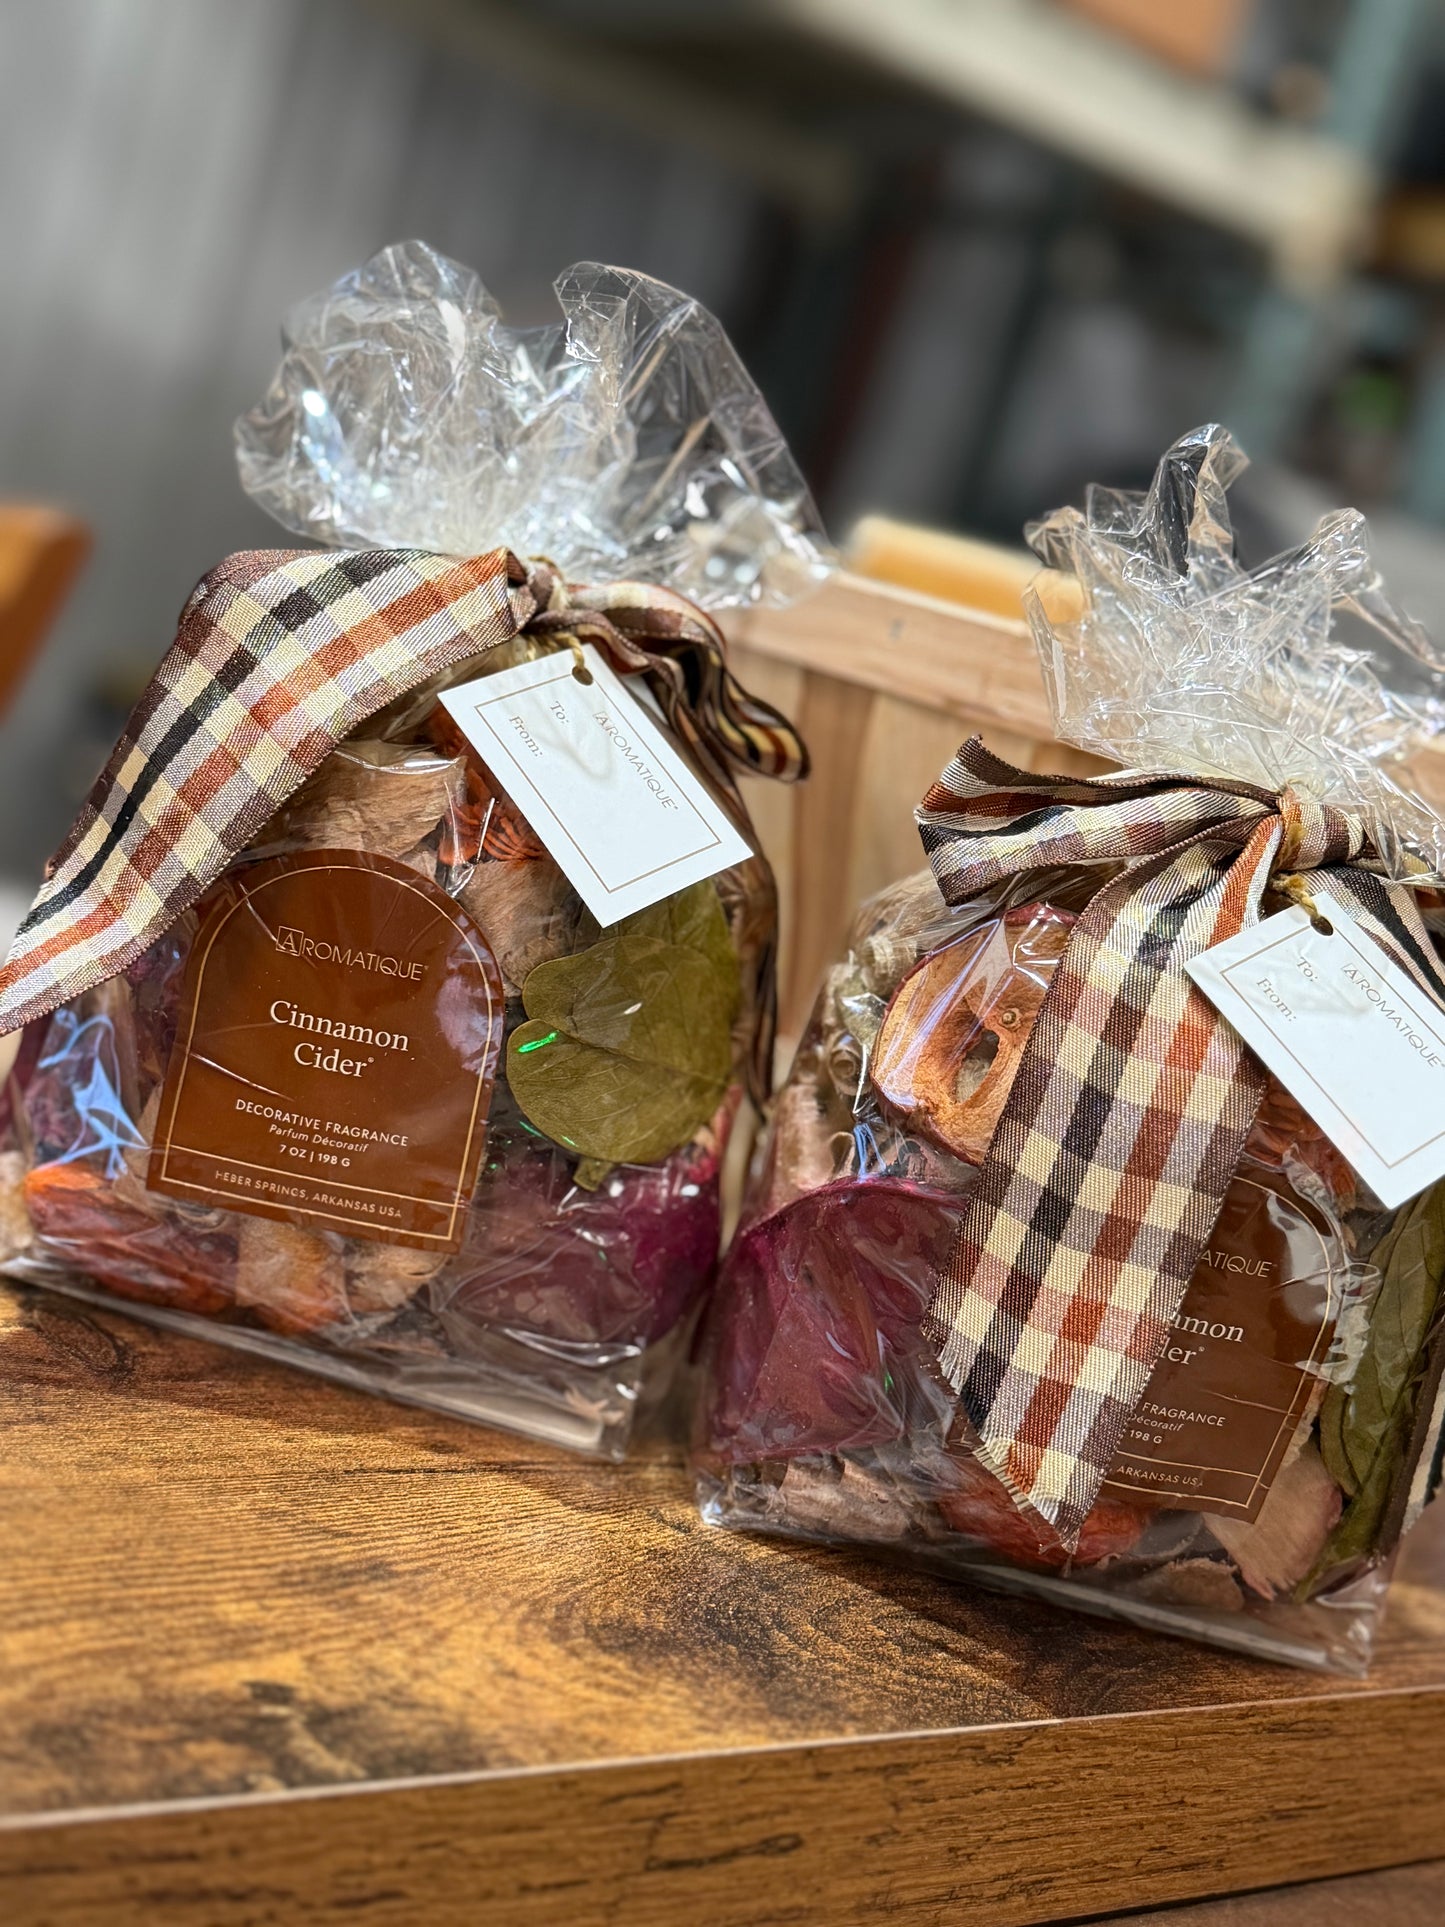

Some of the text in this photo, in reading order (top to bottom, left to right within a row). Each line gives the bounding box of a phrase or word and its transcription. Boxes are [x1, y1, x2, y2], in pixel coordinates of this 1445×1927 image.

[550, 701, 570, 727] To:
[509, 715, 543, 757] From:
[592, 710, 676, 809] AROMATIQUE
[275, 925, 424, 982] AROMATIQUE
[1295, 957, 1320, 983] To:
[1256, 977, 1297, 1022] From:
[1340, 962, 1442, 1068] AROMATIQUE
[270, 1000, 409, 1052] Cinnamon
[235, 1099, 409, 1147] DECORATIVE FRAGRANCE
[269, 1124, 369, 1153] Parfum Décoratif
[279, 1145, 287, 1153] 7
[289, 1147, 307, 1159] OZ
[317, 1152, 338, 1165] 198
[341, 1157, 351, 1167] G
[215, 1170, 251, 1187] HEBER
[312, 1192, 375, 1213] ARKANSAS
[379, 1206, 402, 1218] USA
[1201, 1249, 1273, 1278] ATIQUE
[1142, 1402, 1226, 1427] FRAGRANCE
[1130, 1429, 1163, 1444] 198 G
[1117, 1465, 1180, 1483] ARKANSAS
